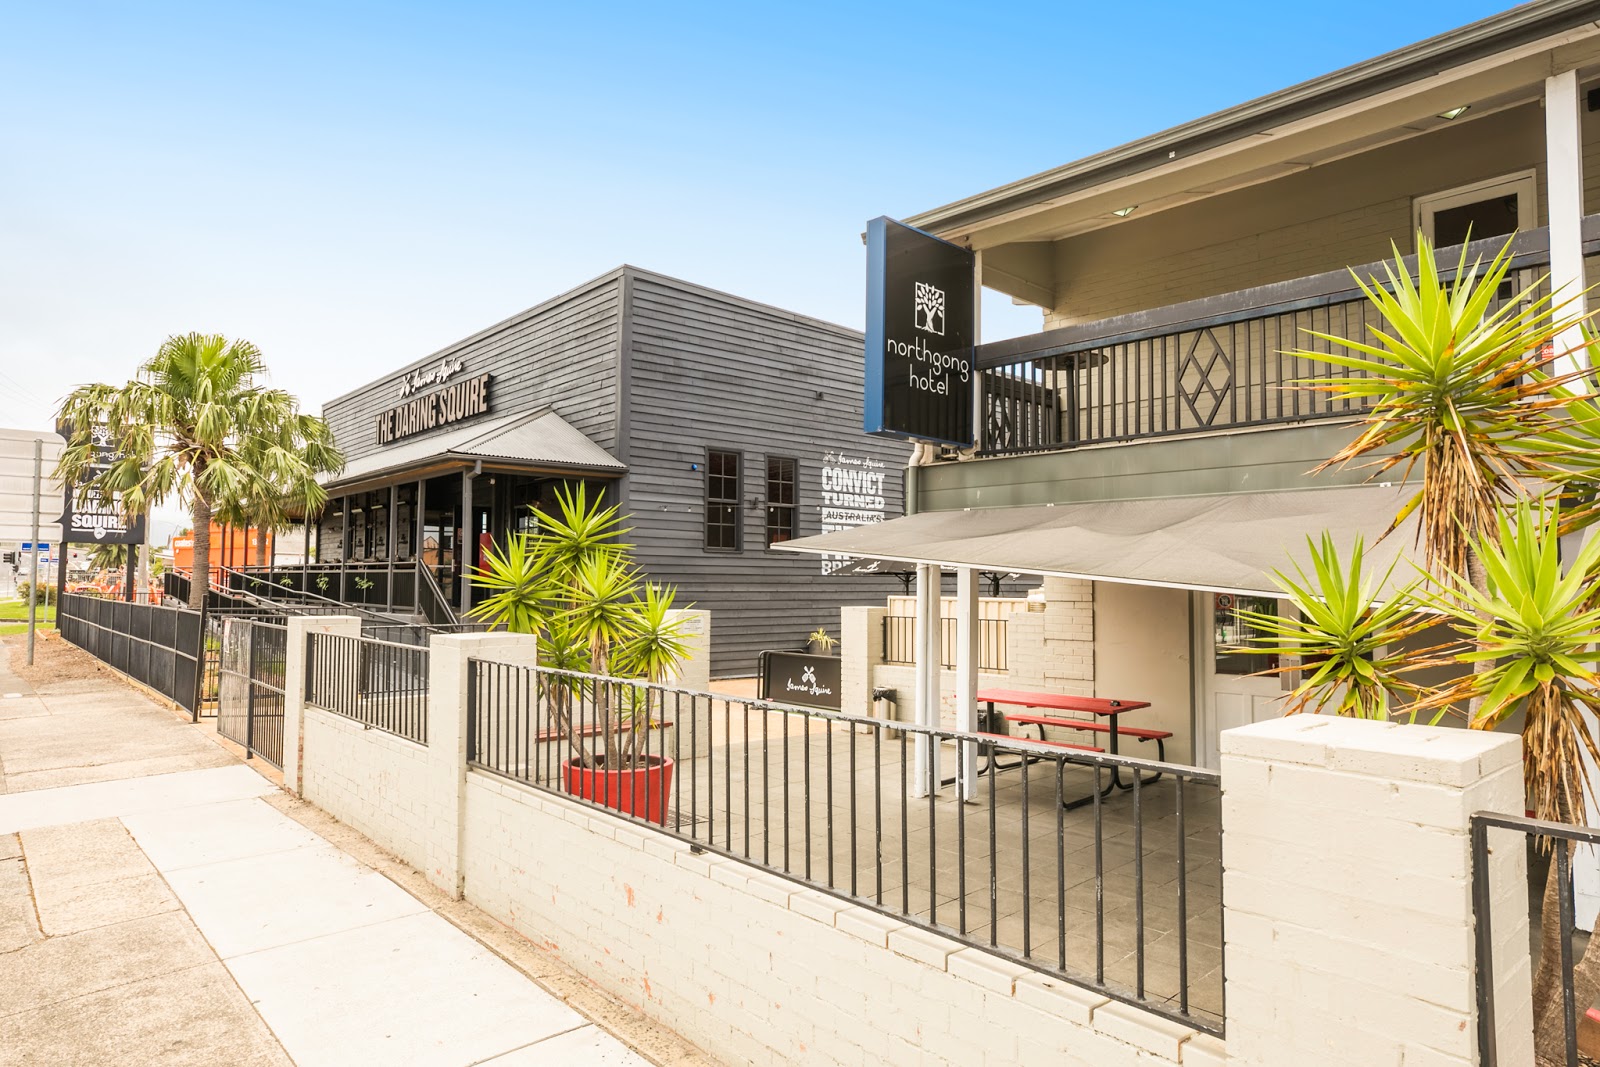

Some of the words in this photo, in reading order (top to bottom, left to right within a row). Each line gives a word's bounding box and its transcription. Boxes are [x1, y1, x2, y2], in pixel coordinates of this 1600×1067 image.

[887, 336, 969, 382] northgong
[909, 363, 949, 396] hotel
[375, 408, 394, 445] THE
[394, 393, 437, 439] DARING
[438, 372, 489, 425] SQUIRE
[838, 452, 861, 465] James
[863, 456, 886, 469] Squire
[821, 466, 885, 495] CONVICT
[821, 491, 886, 510] TURNED
[825, 510, 882, 523] AUSTRALIA'S
[786, 677, 808, 692] James
[809, 682, 832, 696] Squire
